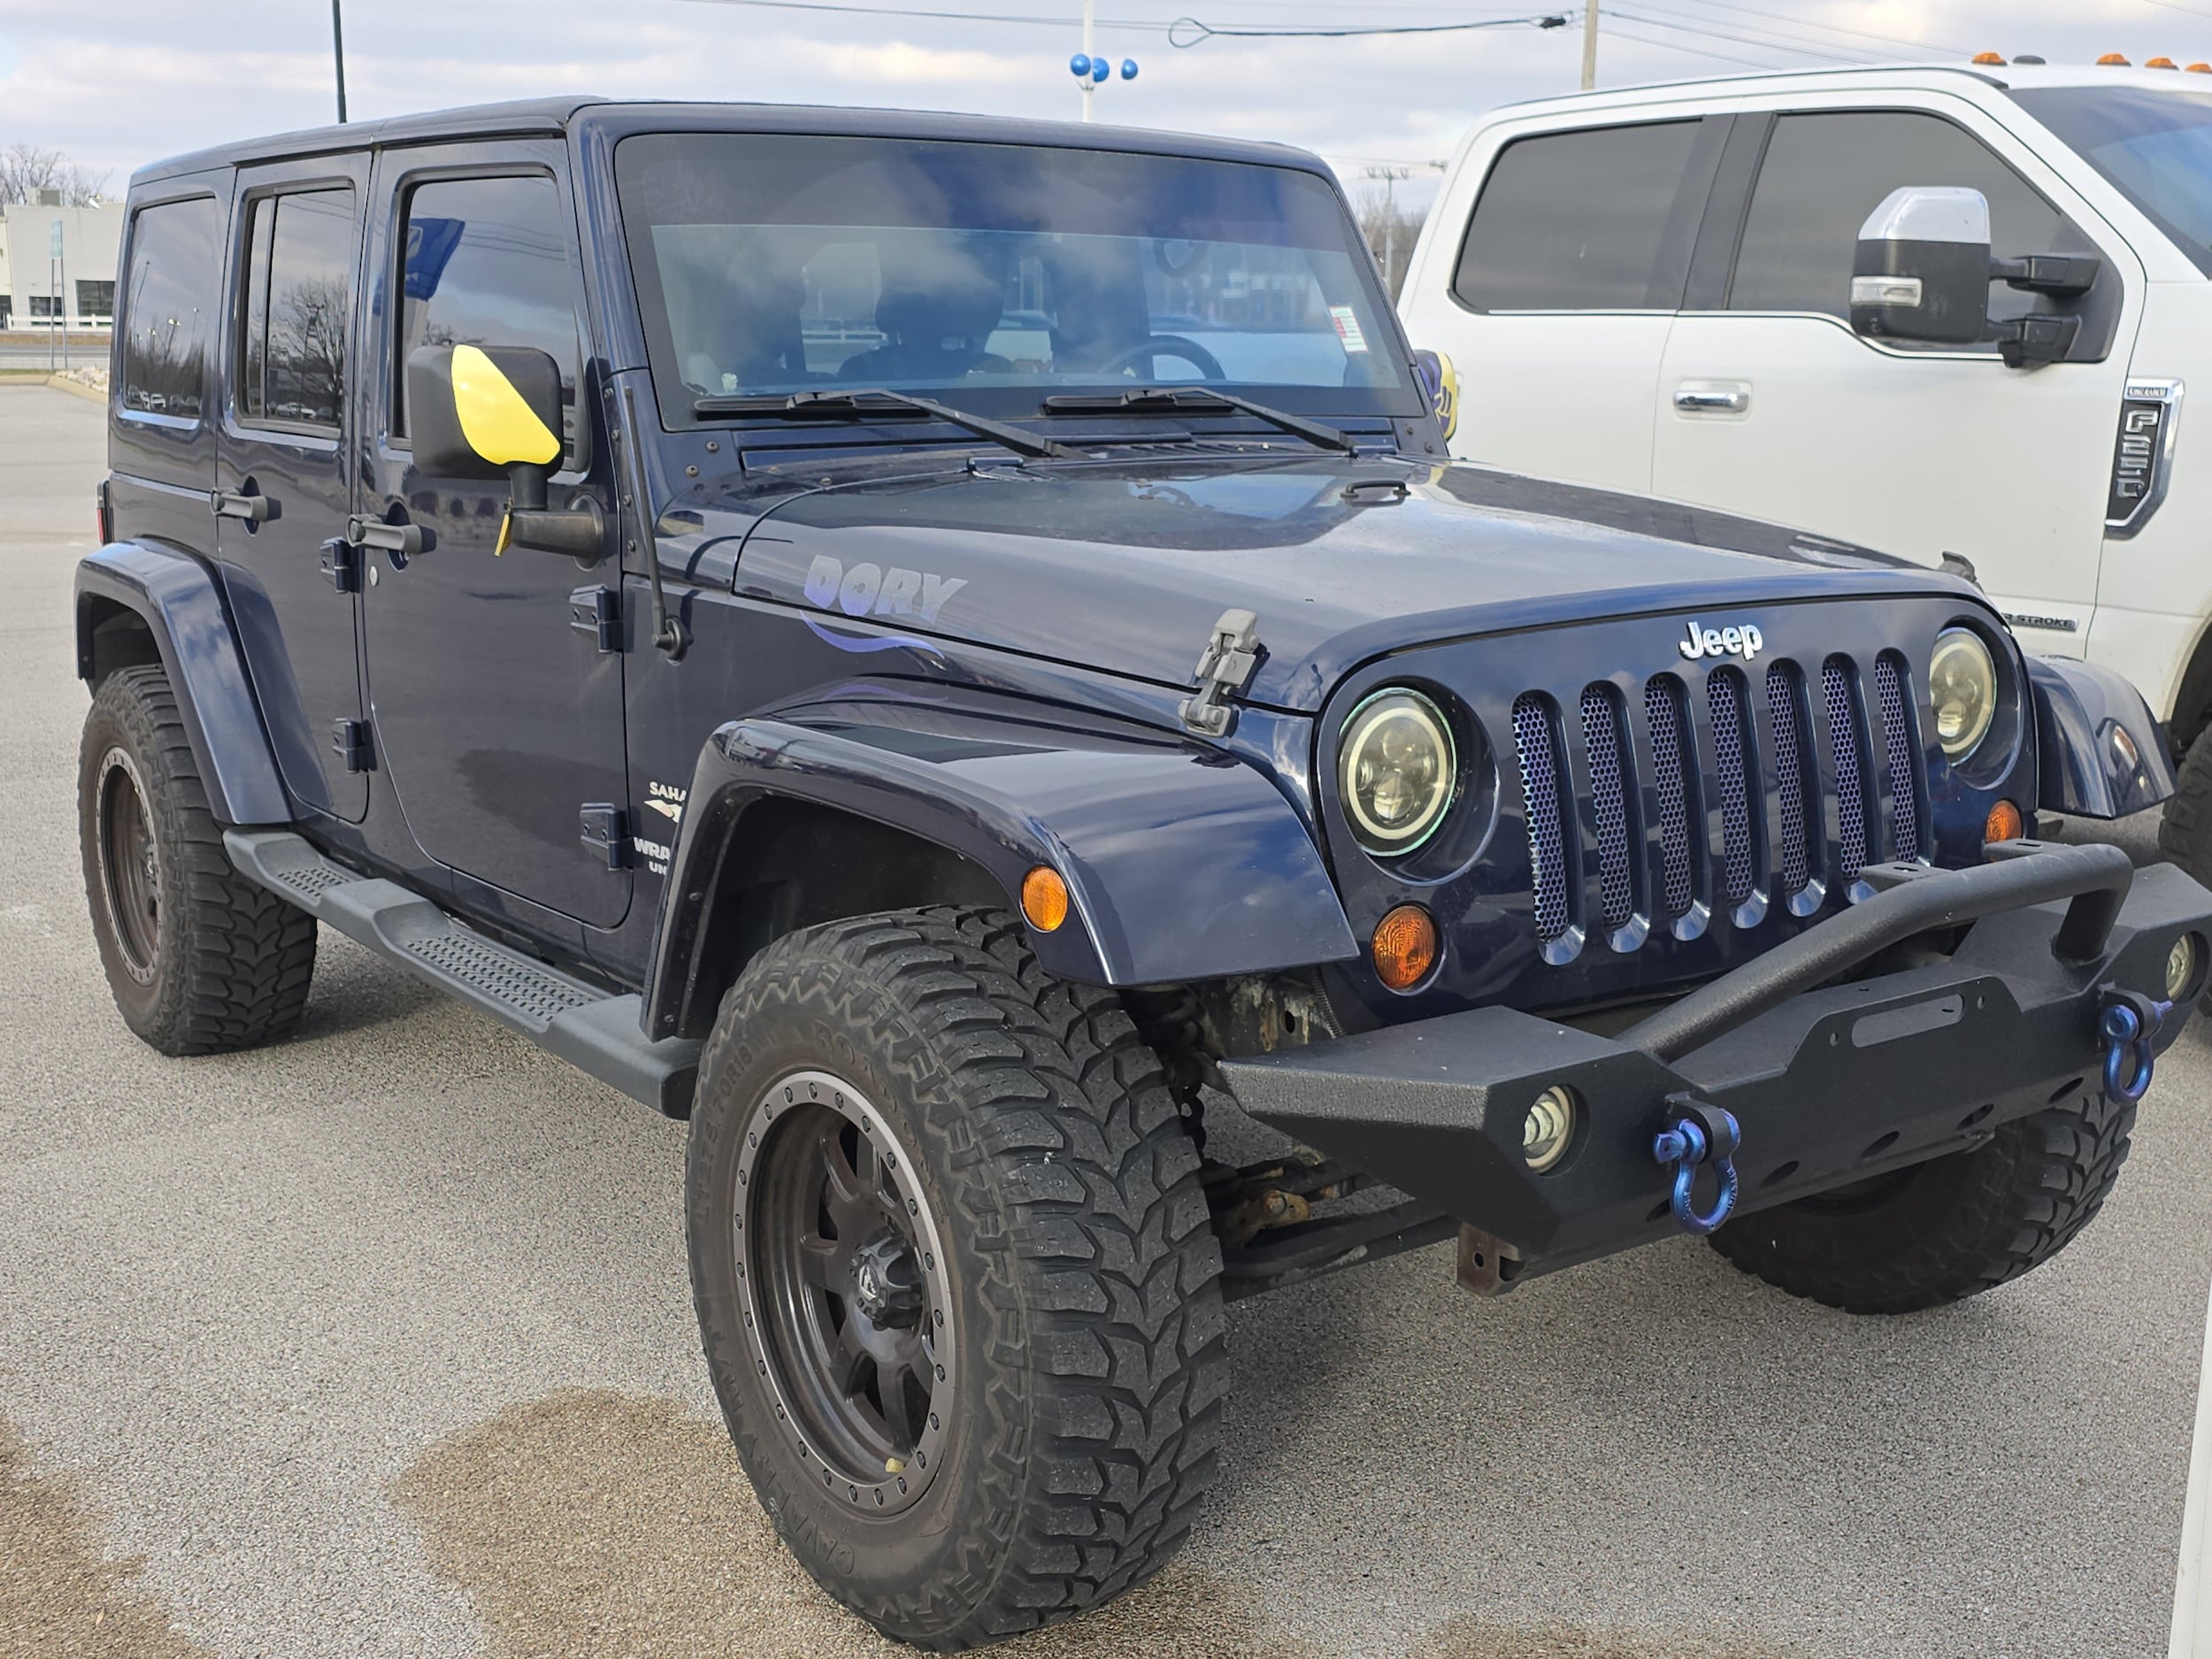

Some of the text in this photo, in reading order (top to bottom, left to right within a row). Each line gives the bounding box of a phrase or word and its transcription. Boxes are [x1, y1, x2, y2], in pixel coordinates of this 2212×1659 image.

[804, 555, 968, 626] DORY
[1678, 621, 1763, 662] Jeep
[2017, 614, 2077, 630] STROKE
